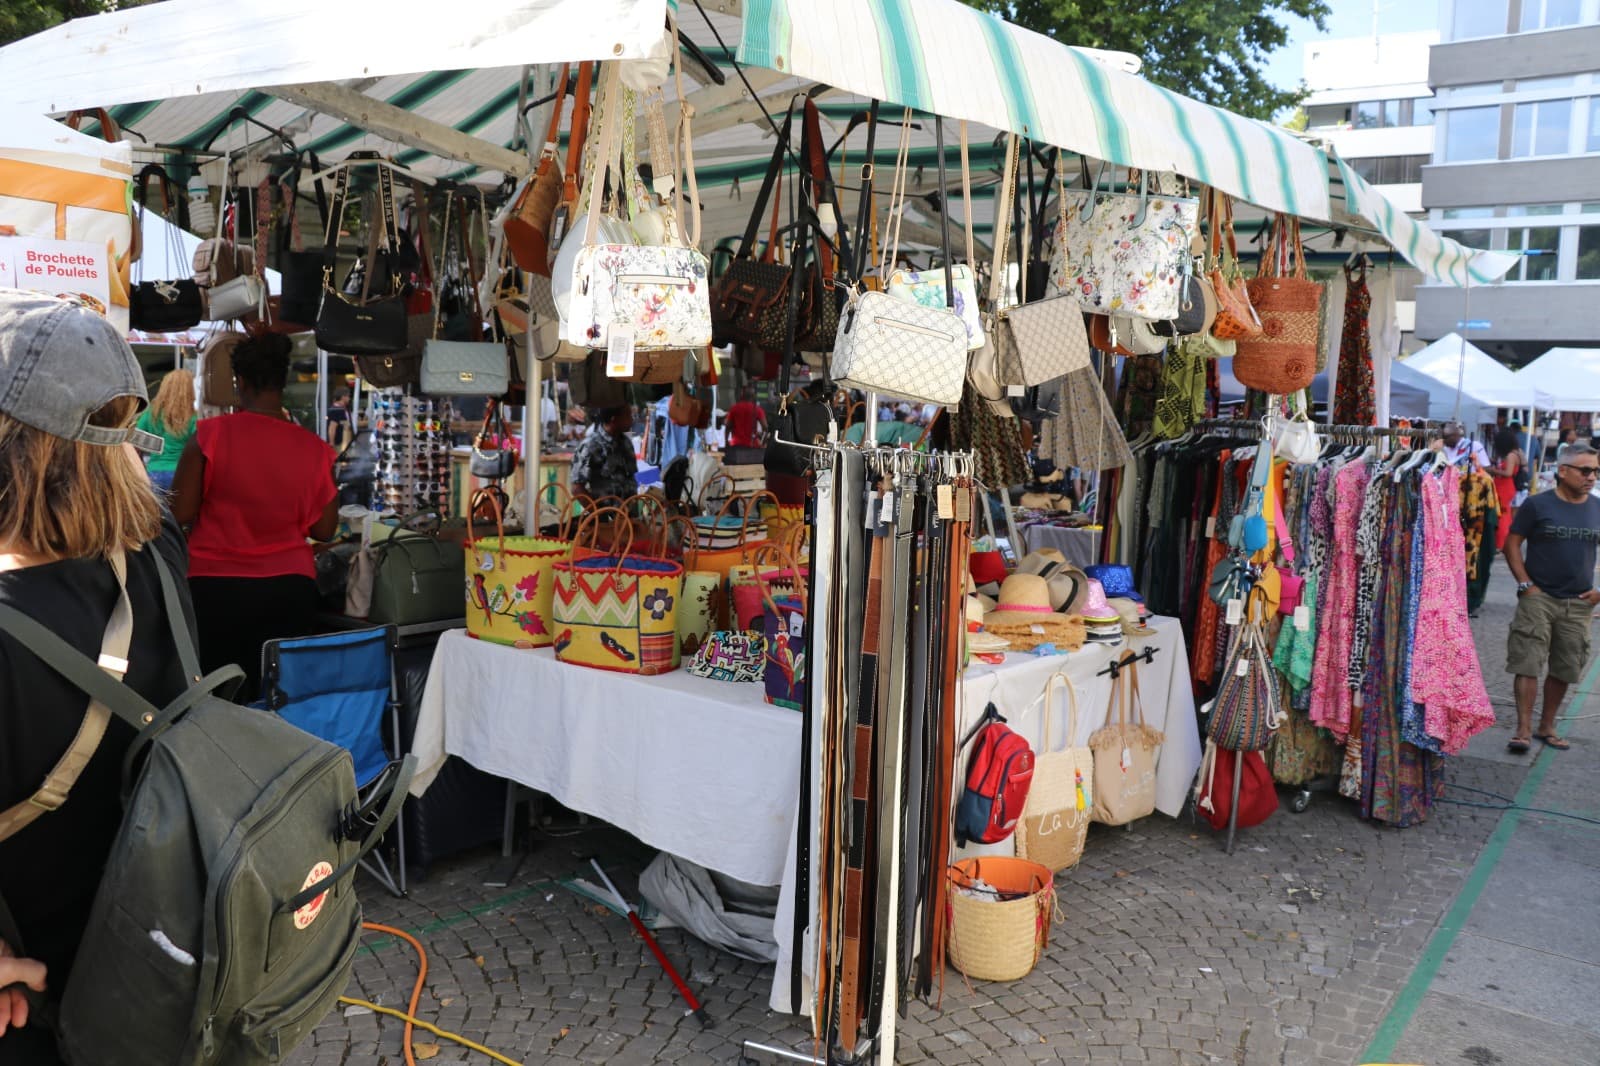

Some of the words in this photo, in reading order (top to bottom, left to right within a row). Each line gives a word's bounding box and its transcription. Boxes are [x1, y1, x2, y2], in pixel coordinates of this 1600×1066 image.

[381, 165, 391, 190] YEA
[383, 190, 393, 223] SWEET
[26, 250, 95, 265] Brochette
[25, 264, 43, 275] de
[47, 265, 98, 278] Poulets
[1038, 812, 1063, 836] La
